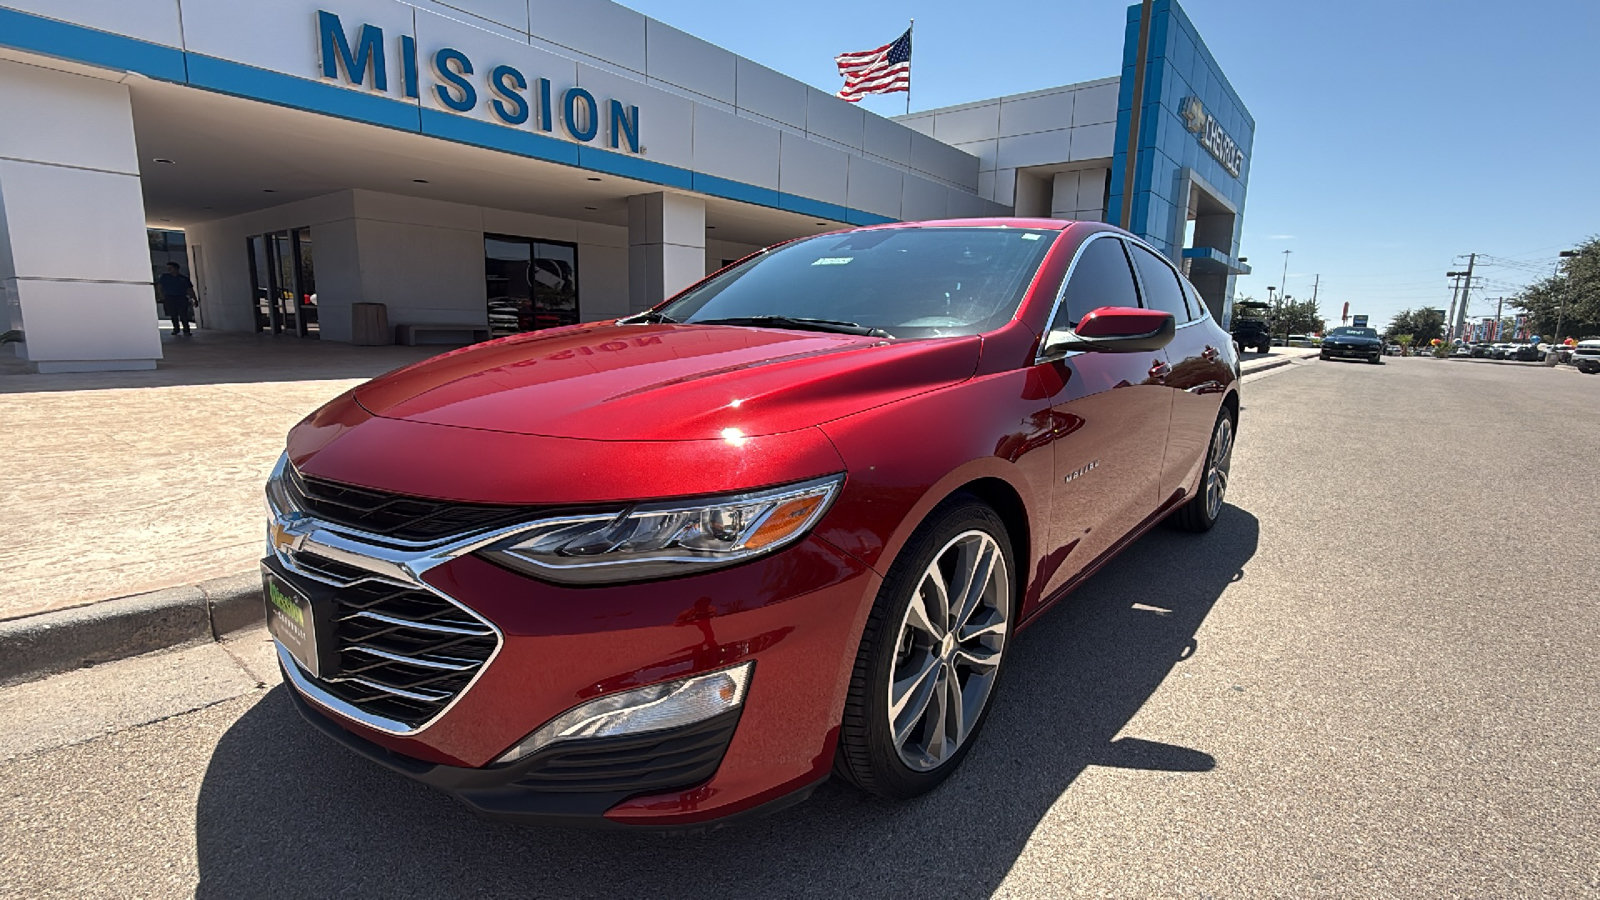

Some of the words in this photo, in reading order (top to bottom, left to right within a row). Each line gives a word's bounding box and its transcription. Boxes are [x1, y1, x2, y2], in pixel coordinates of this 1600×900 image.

[316, 9, 639, 154] MISSION
[1205, 114, 1243, 177] CHEVROLET
[1064, 459, 1101, 484] MALIBU
